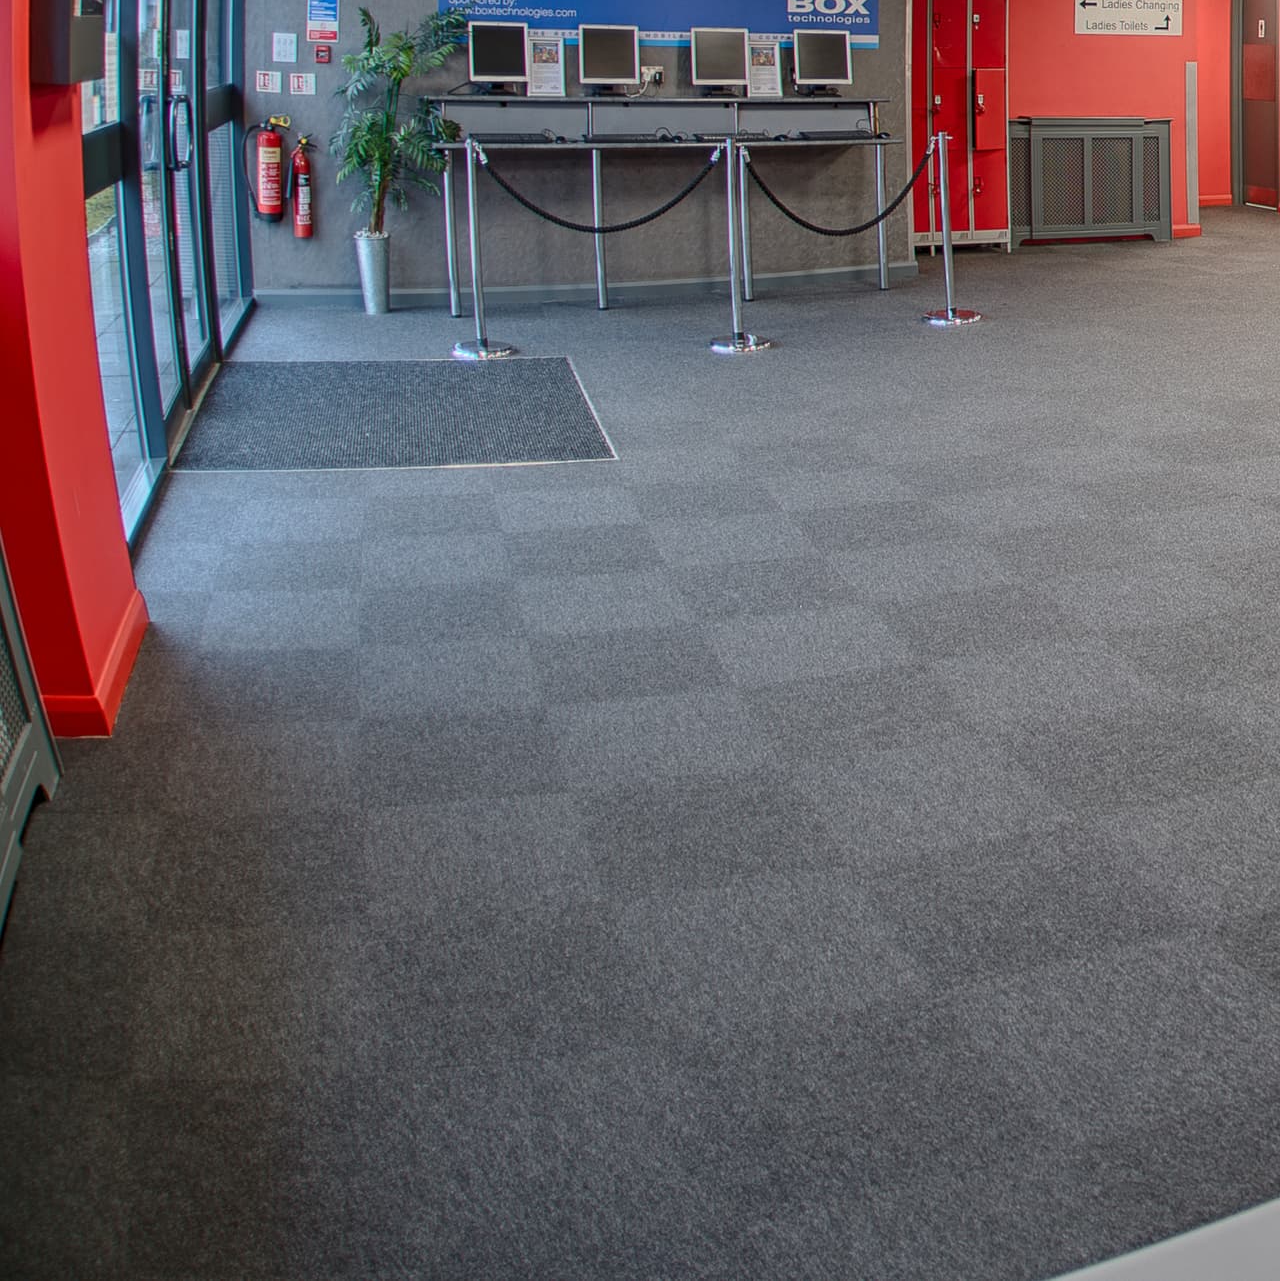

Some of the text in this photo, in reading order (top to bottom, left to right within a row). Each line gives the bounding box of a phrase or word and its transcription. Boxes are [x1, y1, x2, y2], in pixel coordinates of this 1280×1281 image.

[449, 5, 577, 19] w.boxtechnologies.com
[1101, 0, 1180, 13] Ladies Changing
[788, 14, 870, 25] technologies
[1086, 20, 1149, 31] Ladies Toilets
